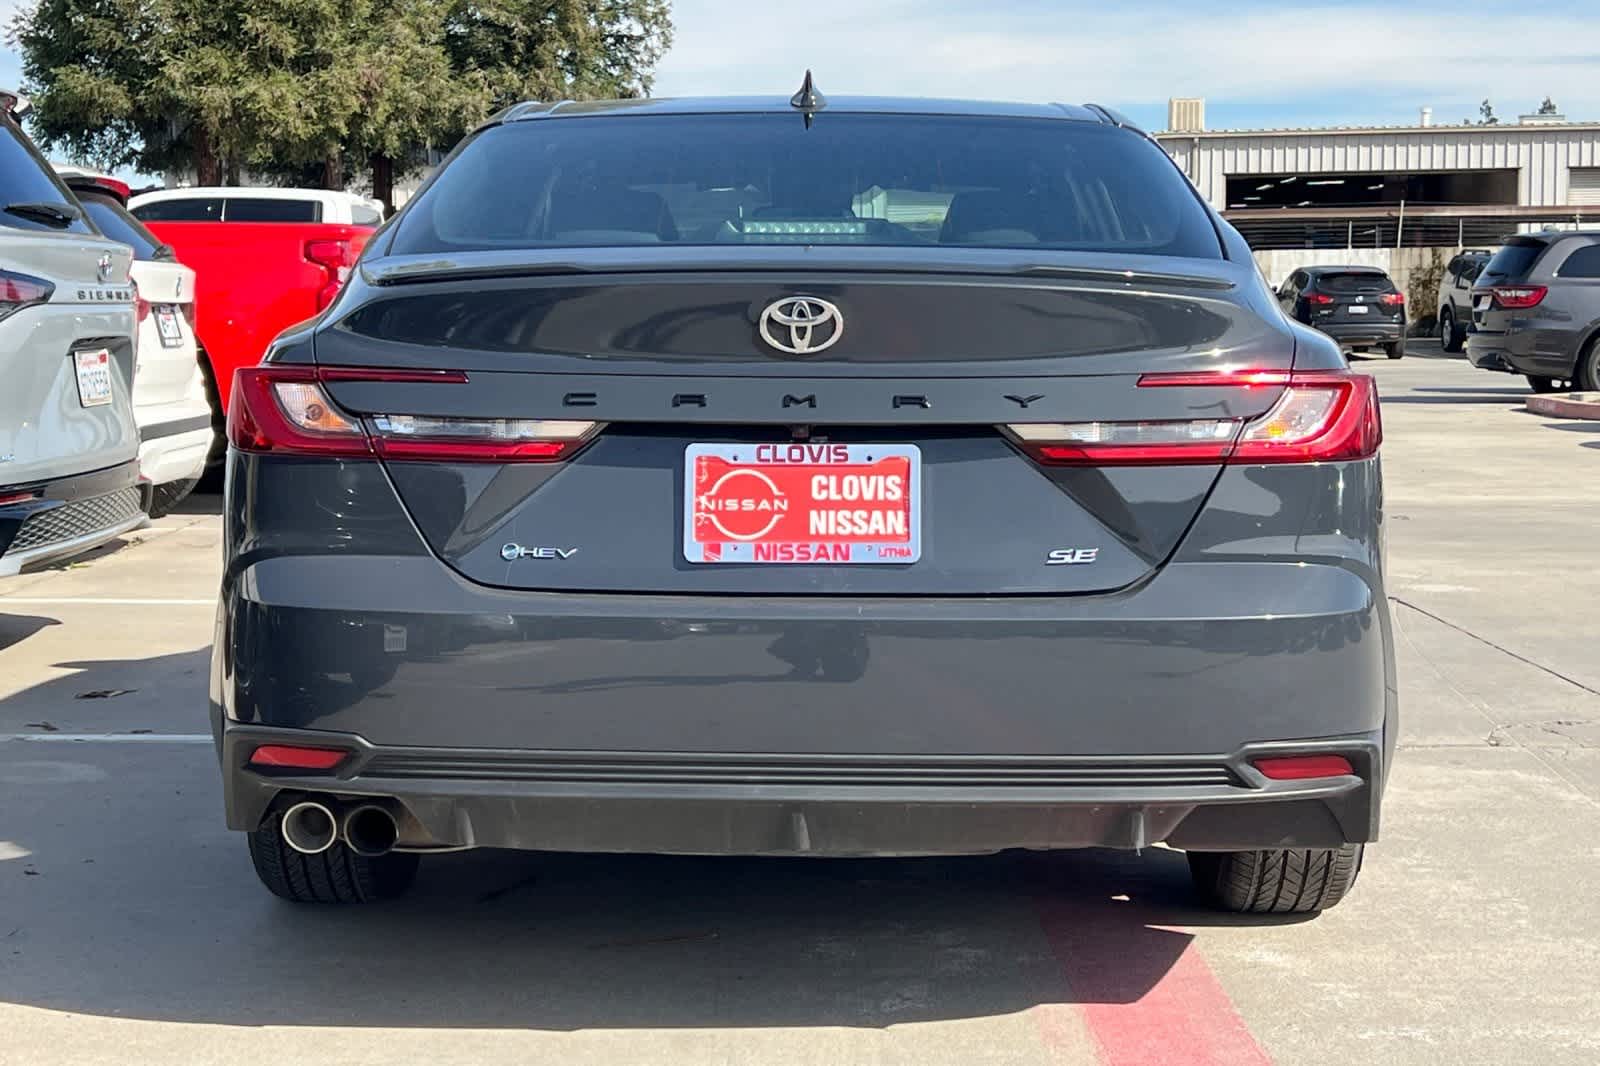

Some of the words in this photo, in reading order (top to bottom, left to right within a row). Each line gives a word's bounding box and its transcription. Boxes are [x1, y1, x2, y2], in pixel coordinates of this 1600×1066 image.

[77, 290, 130, 300] SIENNA
[562, 392, 1046, 408] CAMRY
[756, 444, 849, 463] CLOVIS
[811, 474, 902, 501] CLOVIS
[701, 498, 788, 512] NISSAN
[809, 509, 905, 536] NISSAN
[753, 543, 850, 561] NISSAN
[1045, 548, 1099, 564] SE
